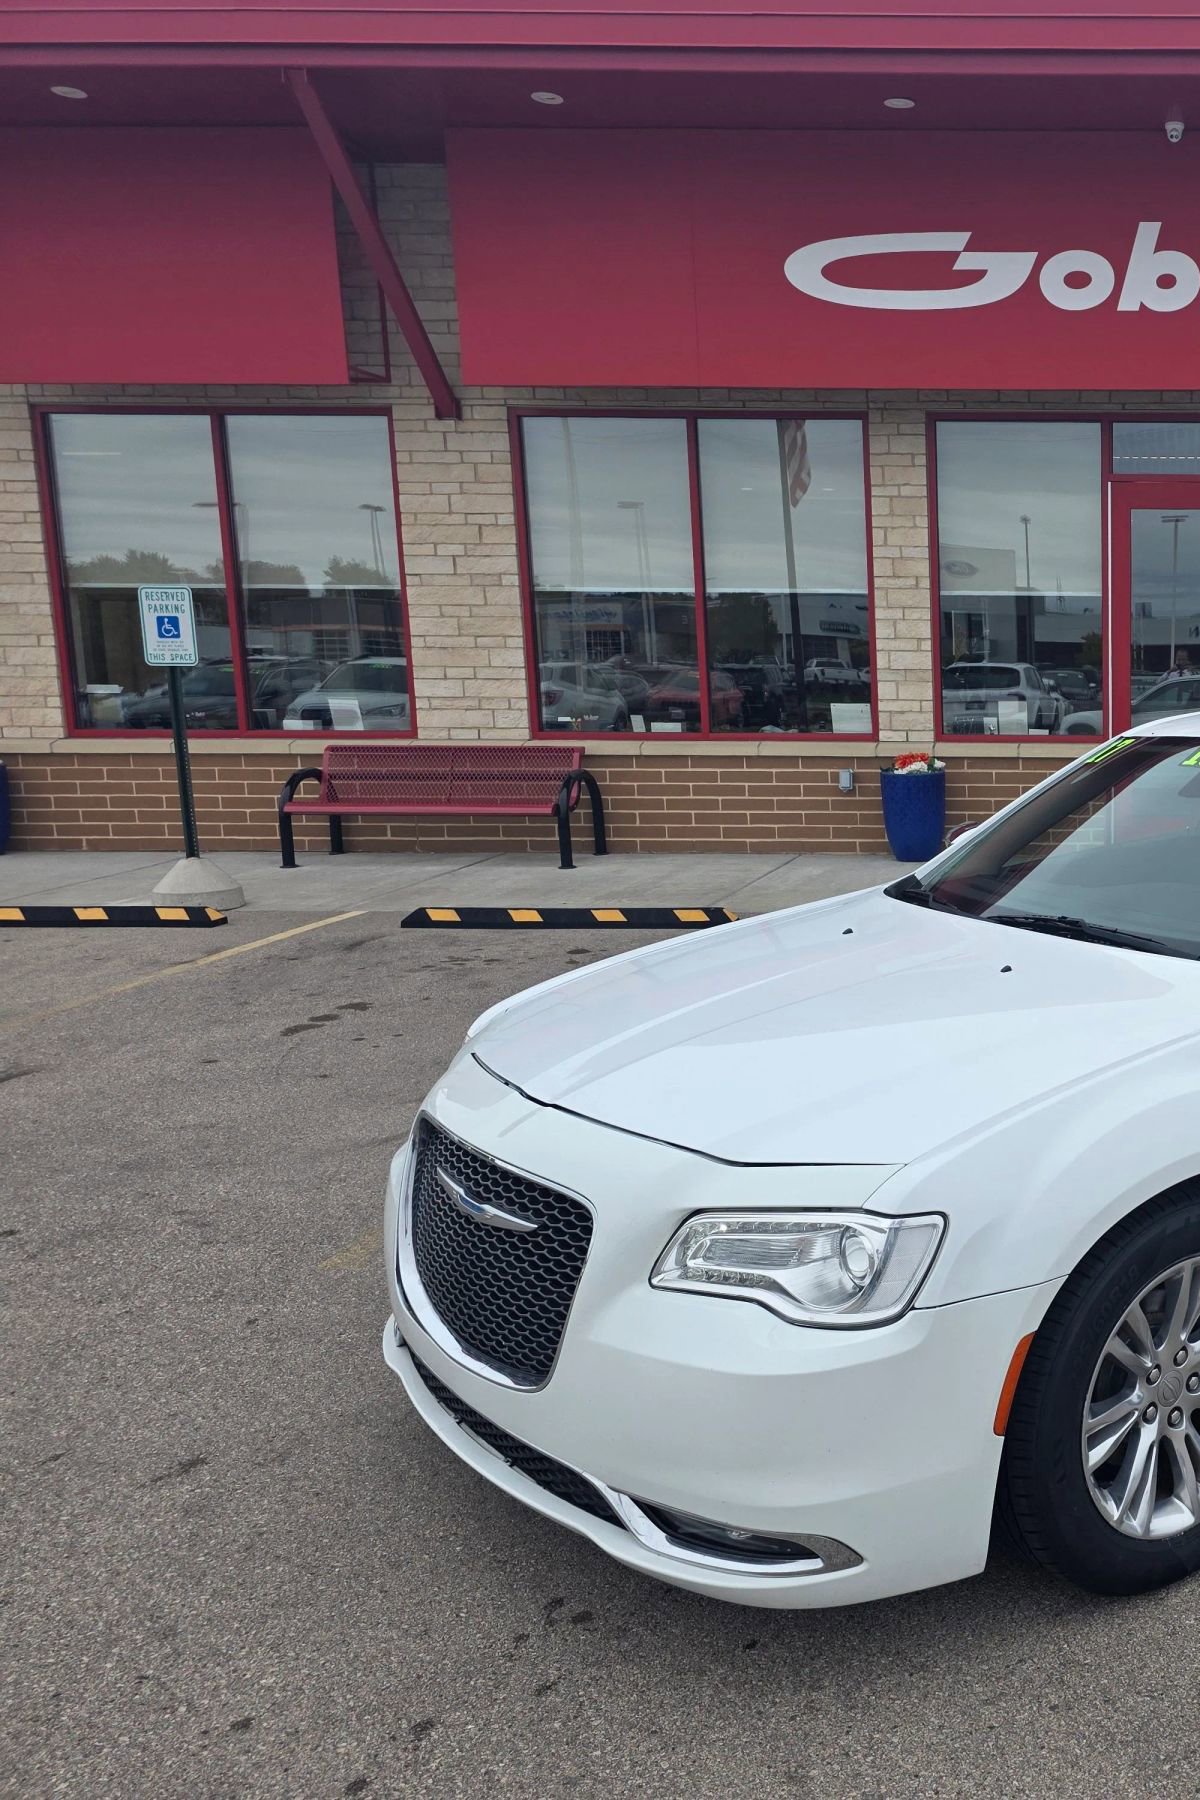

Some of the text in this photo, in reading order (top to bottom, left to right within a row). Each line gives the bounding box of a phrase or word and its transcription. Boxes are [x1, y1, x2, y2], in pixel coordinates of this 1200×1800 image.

[145, 591, 185, 602] RESERVED
[148, 603, 186, 614] PARKING
[149, 652, 193, 662] THIS SPACE
